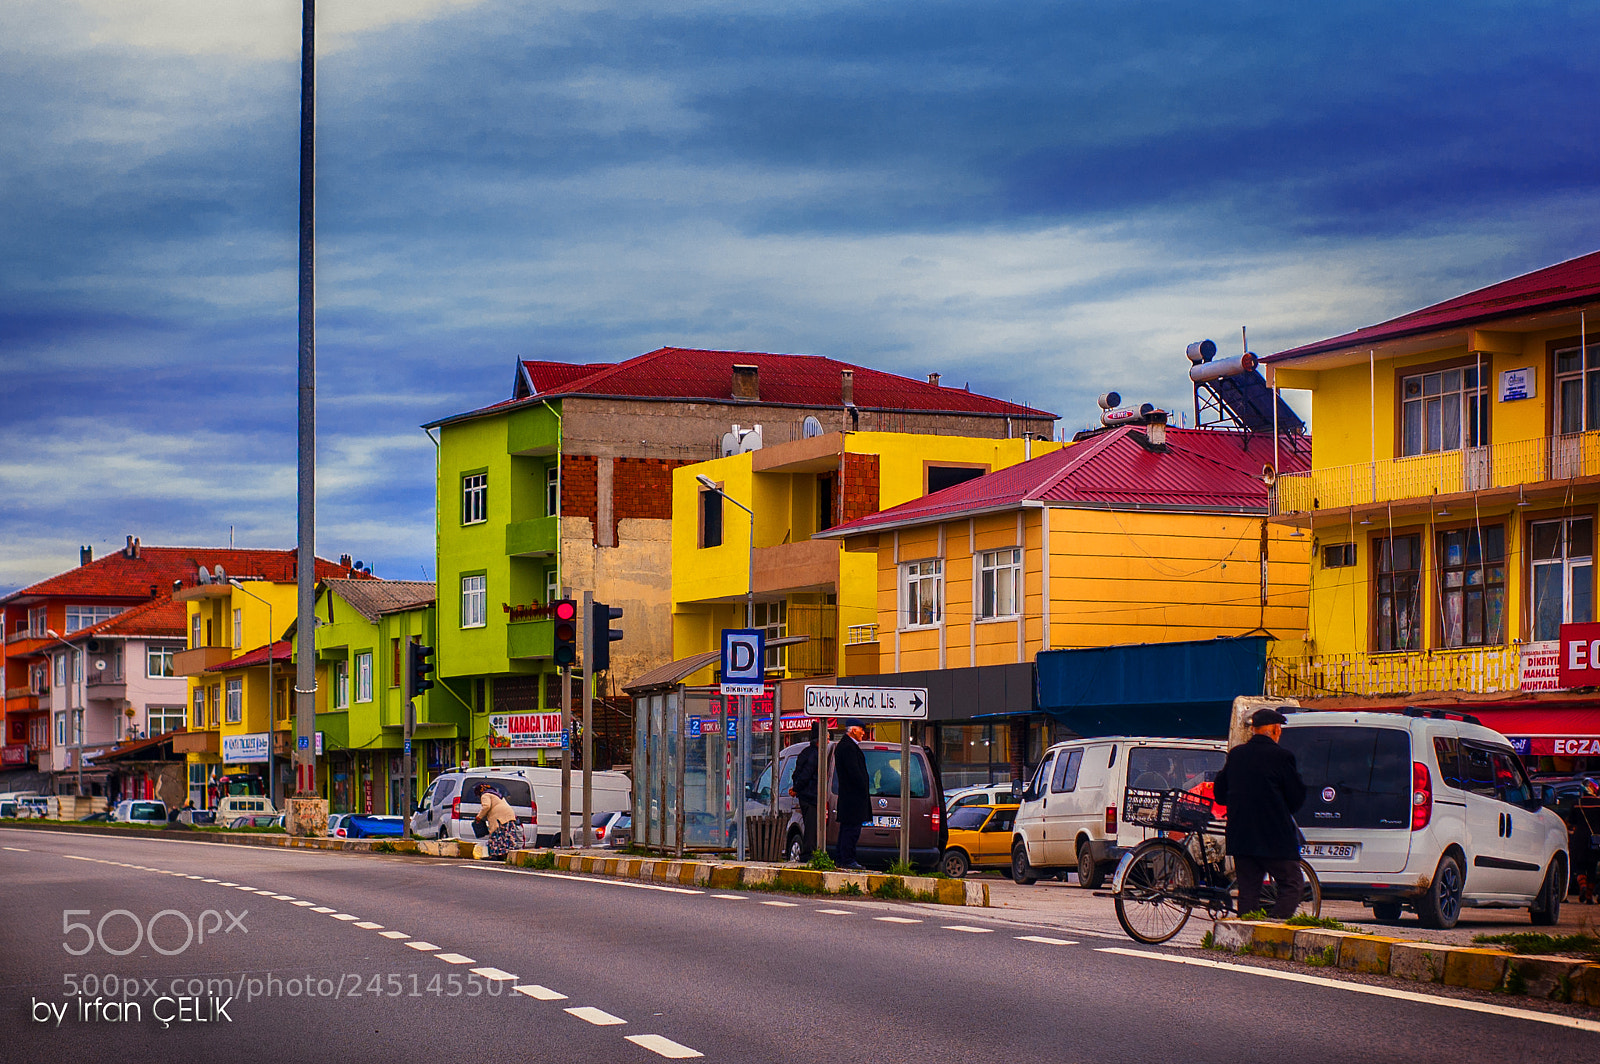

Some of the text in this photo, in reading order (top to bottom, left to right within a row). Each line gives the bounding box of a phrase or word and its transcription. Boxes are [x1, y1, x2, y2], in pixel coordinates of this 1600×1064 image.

[731, 641, 755, 671] D
[809, 691, 897, 711] Dikbıyık And. Lis.
[508, 715, 541, 733] KARACA
[542, 714, 562, 732] TARI
[1300, 846, 1351, 856] 34 HL 4286
